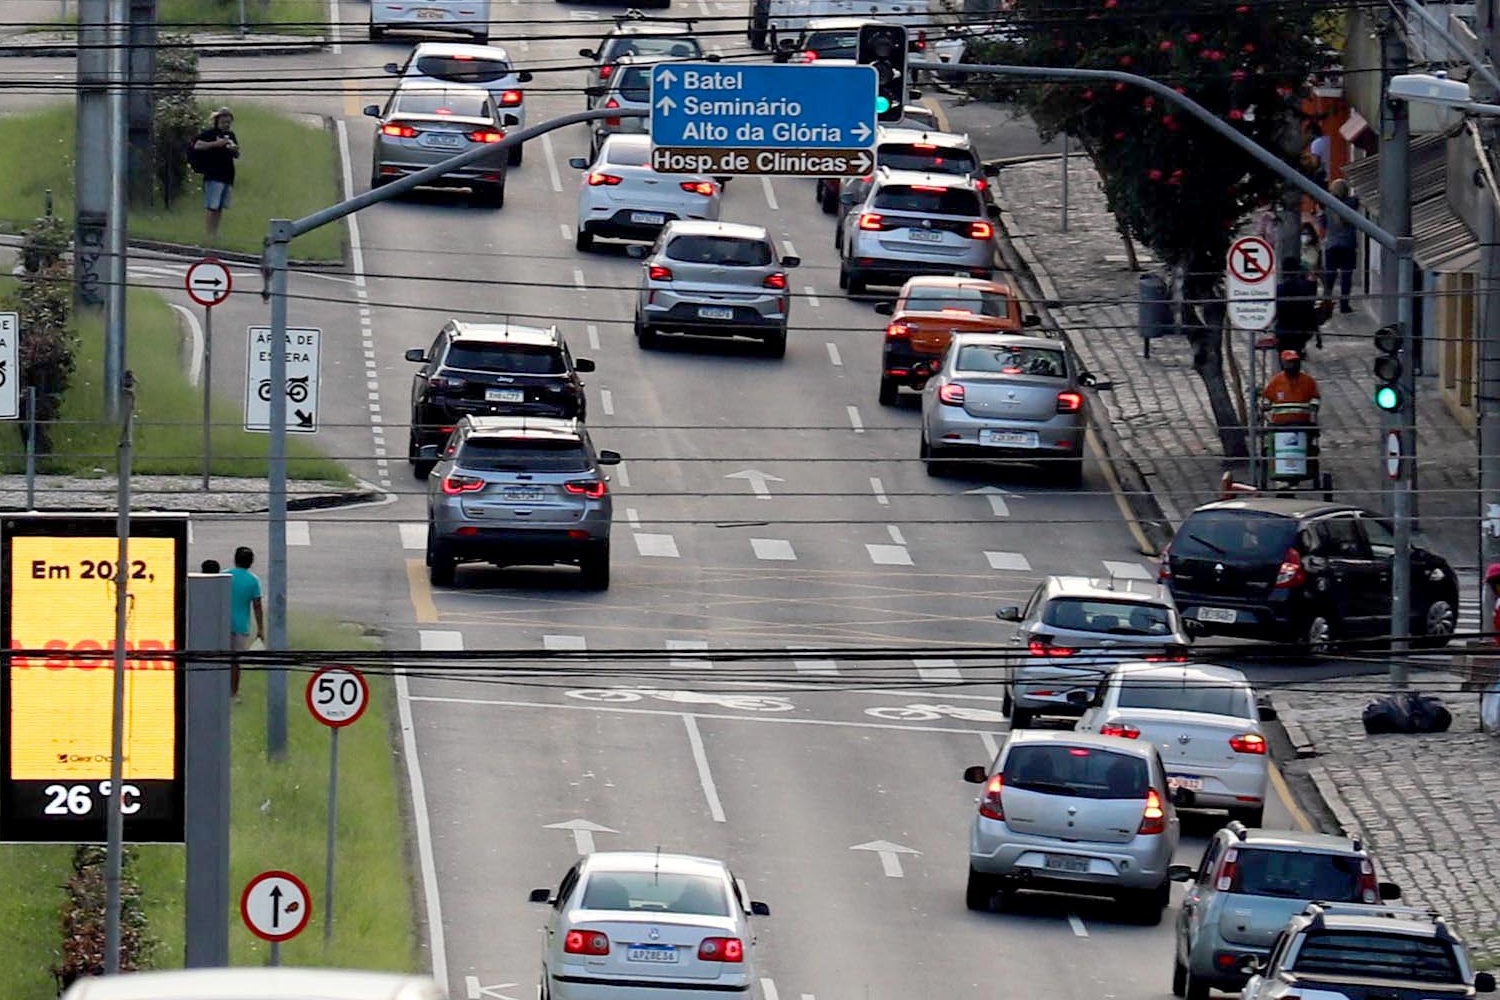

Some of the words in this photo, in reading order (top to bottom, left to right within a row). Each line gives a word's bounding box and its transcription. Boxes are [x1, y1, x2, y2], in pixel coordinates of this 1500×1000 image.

[684, 71, 743, 90] Batel
[684, 96, 801, 116] Seminário
[682, 121, 728, 141] Alto
[736, 123, 765, 141] da
[772, 122, 841, 142] Glória
[756, 153, 847, 172] Clínicas
[256, 331, 291, 345] ÁRA
[297, 335, 313, 345] DE
[259, 351, 310, 362] ESERA
[32, 560, 70, 579] Em
[80, 560, 155, 583] 202,
[317, 678, 358, 705] 50
[44, 784, 92, 815] 26
